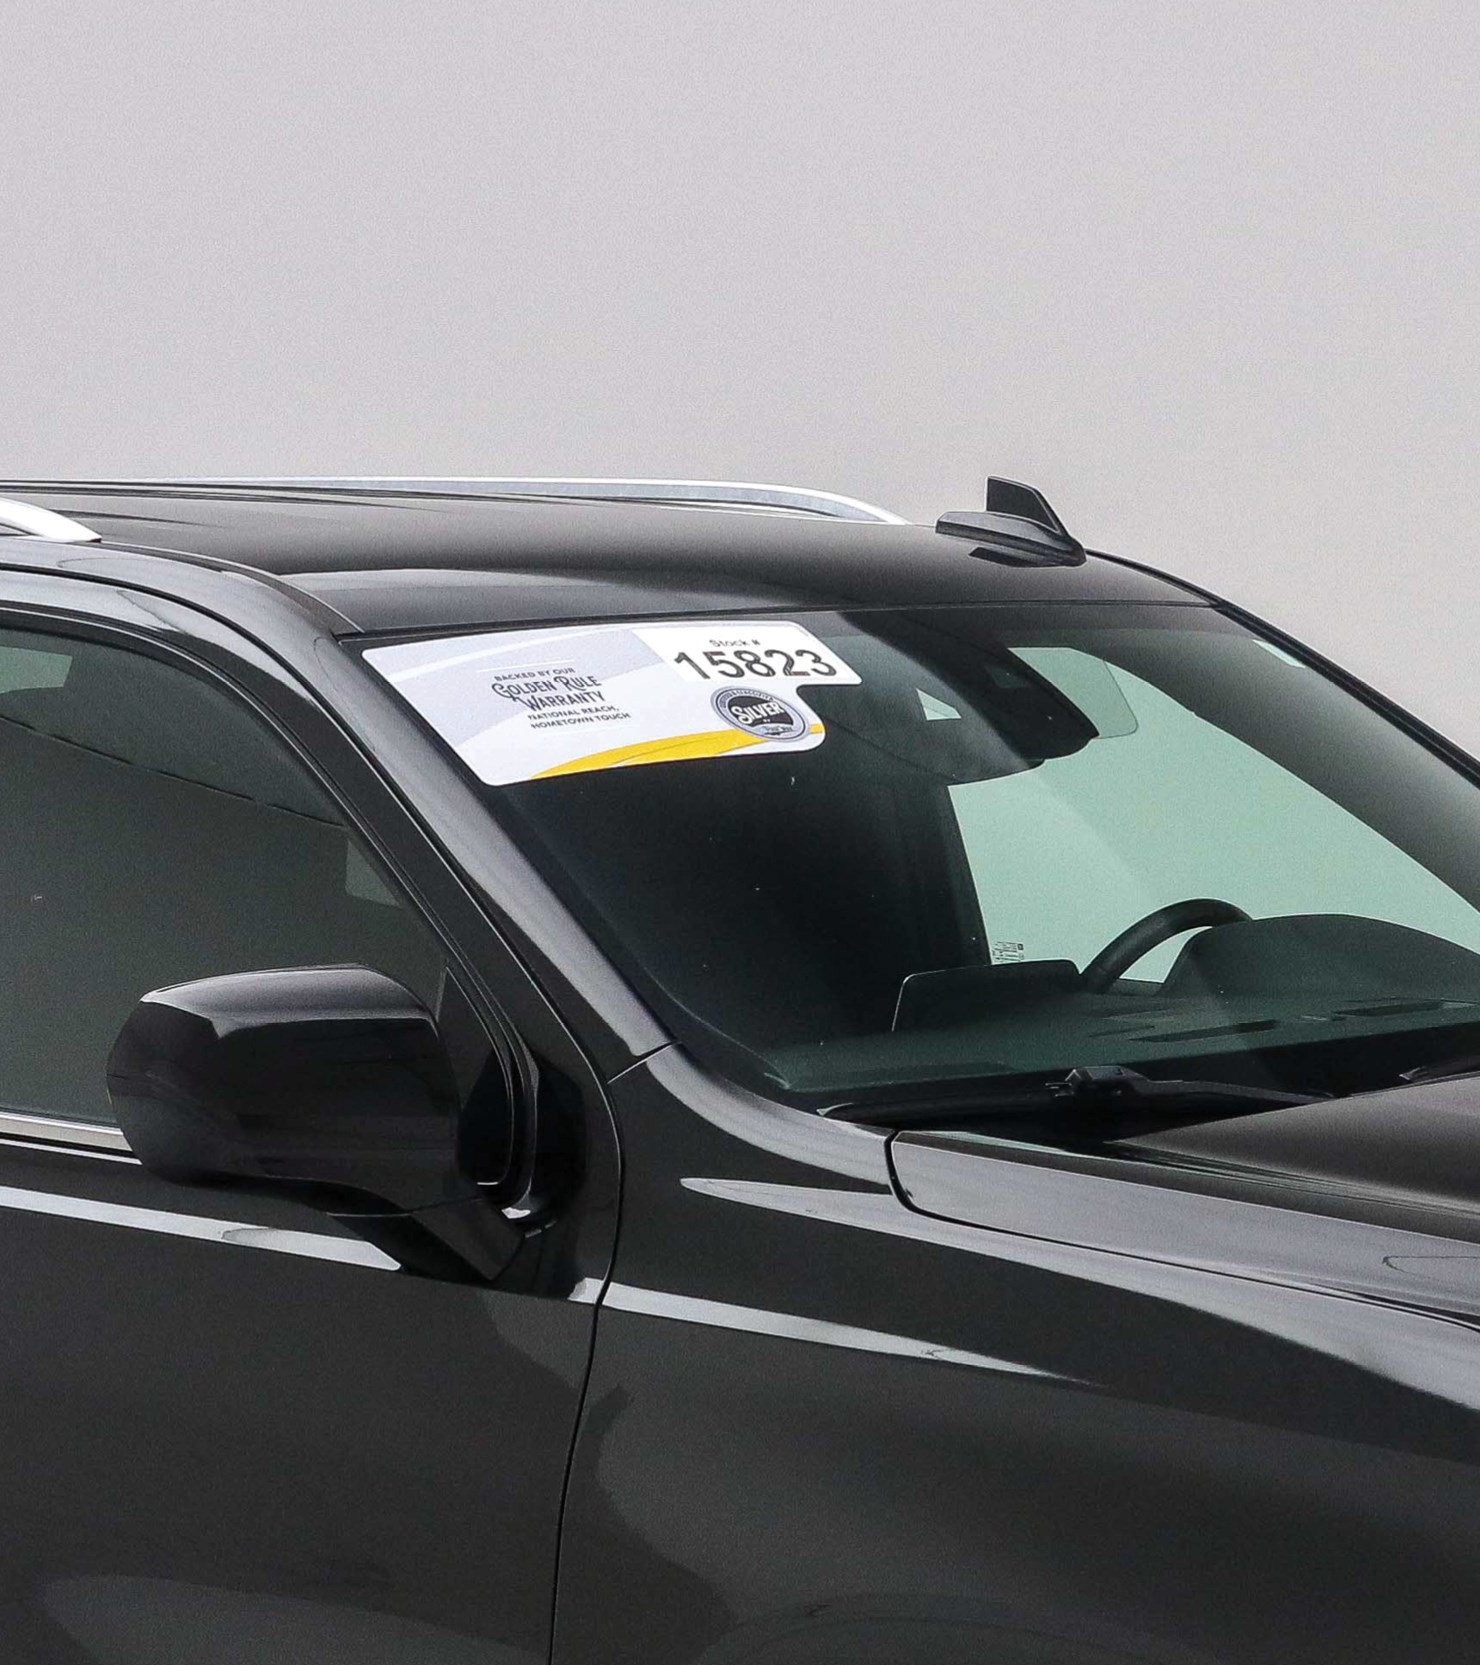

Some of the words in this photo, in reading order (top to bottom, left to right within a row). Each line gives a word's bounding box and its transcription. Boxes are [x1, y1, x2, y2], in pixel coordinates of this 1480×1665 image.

[493, 671, 536, 682] BACKED
[537, 669, 551, 677] BY
[552, 666, 577, 676] OUR
[673, 648, 837, 680] 15823
[491, 678, 558, 703] GOLDEN
[552, 674, 603, 692] RULE
[513, 690, 607, 713] WARRANTY
[527, 708, 581, 721] NATIONAL
[581, 704, 620, 715] REACH,
[730, 700, 785, 725] SILVER
[530, 716, 595, 730] HOMETOWN
[595, 711, 632, 722] TOUCH
